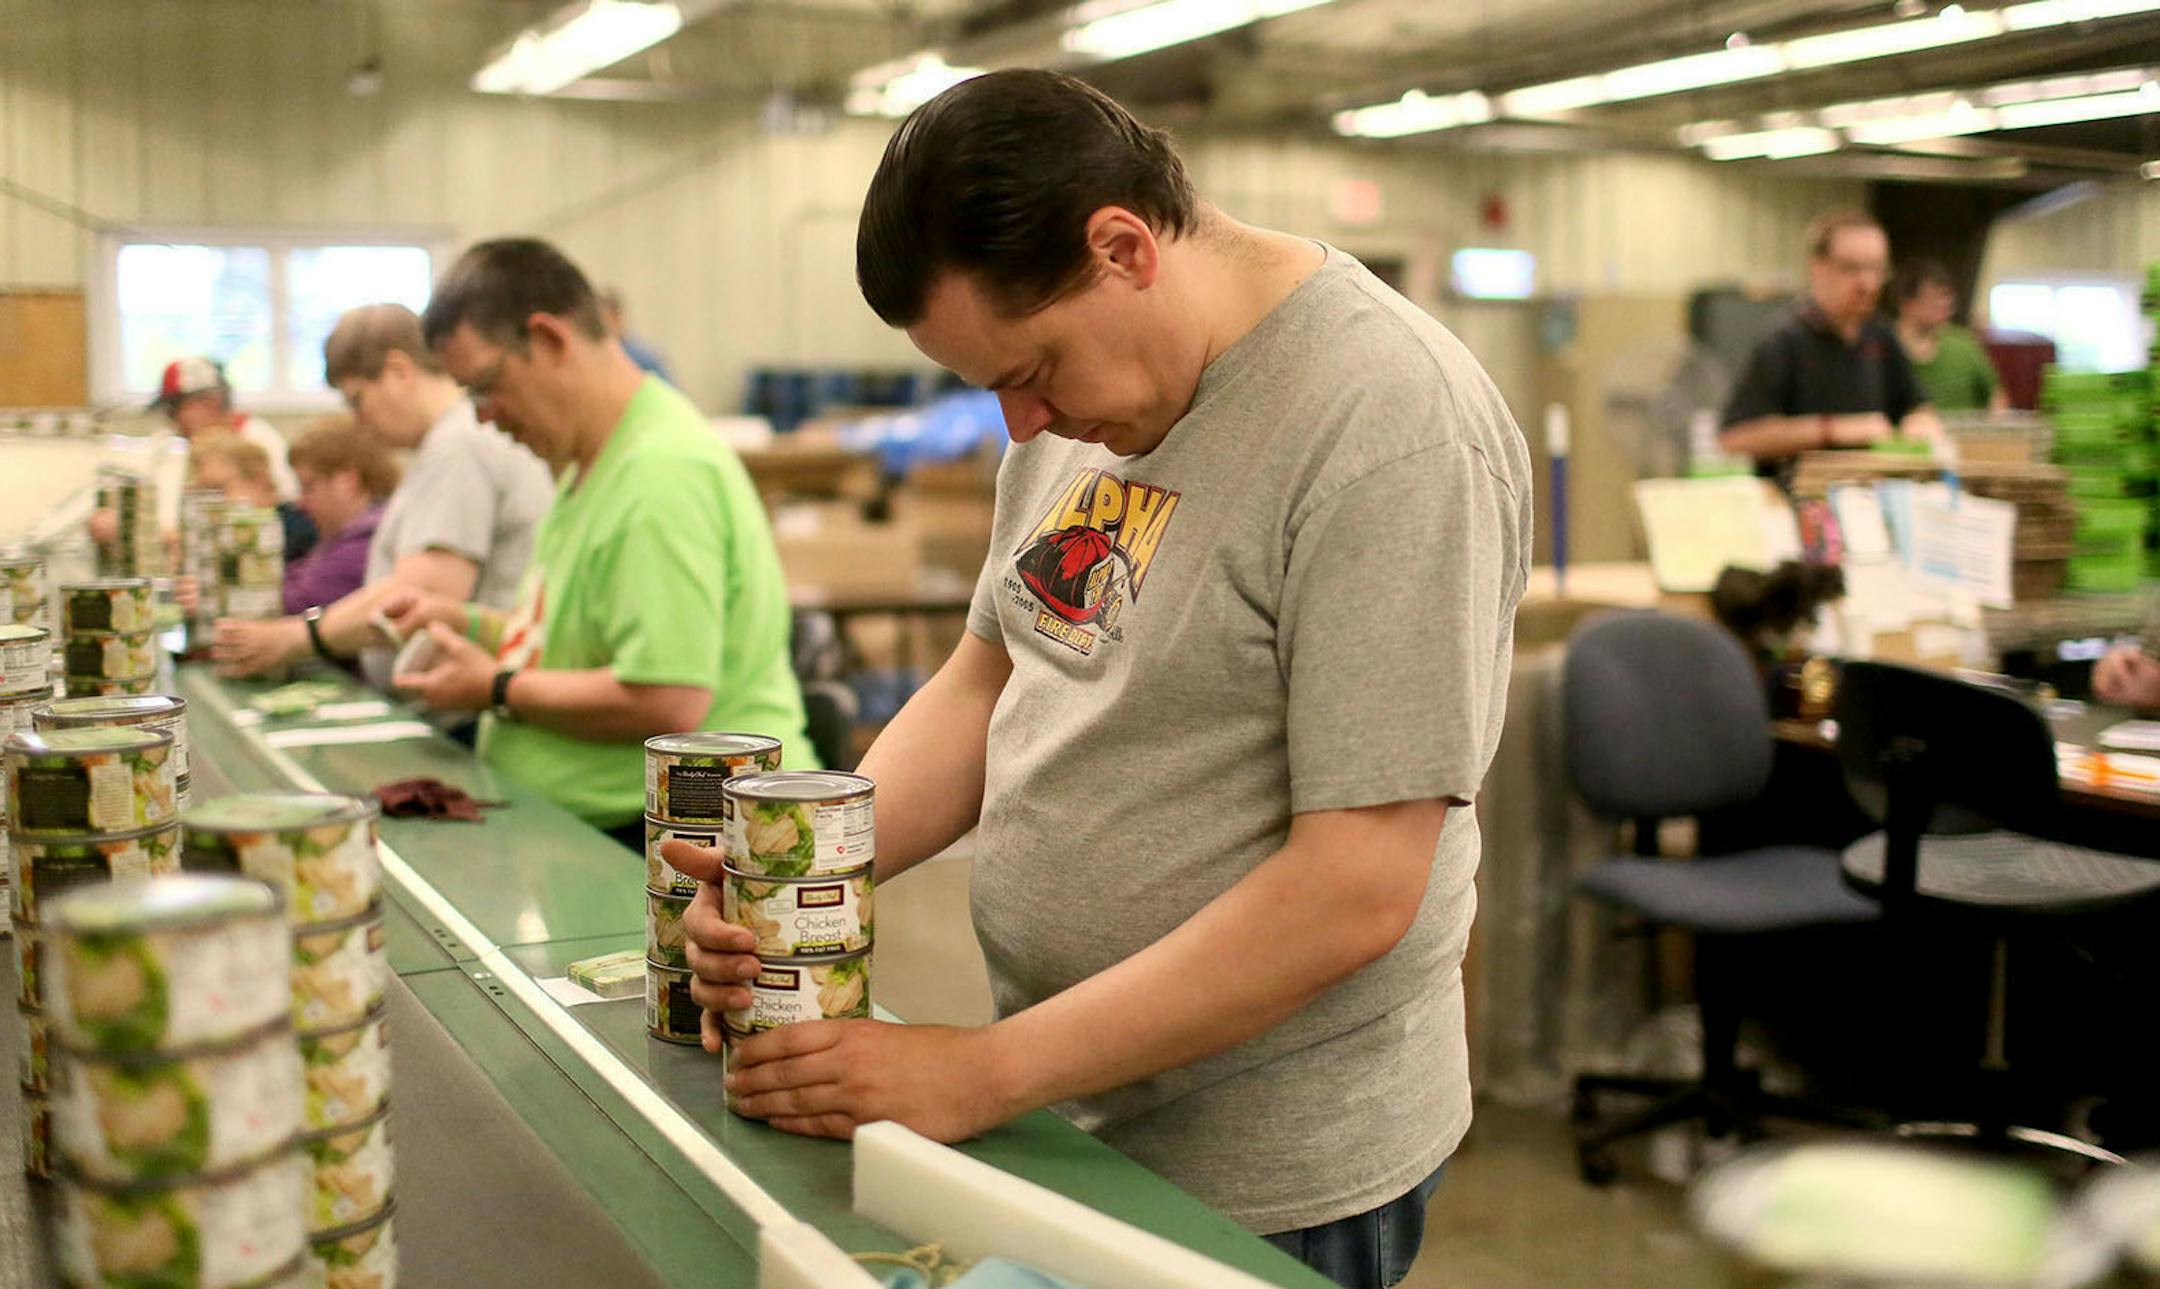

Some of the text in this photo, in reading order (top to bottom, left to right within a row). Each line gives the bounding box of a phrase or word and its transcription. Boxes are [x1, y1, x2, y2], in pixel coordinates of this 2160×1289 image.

[1013, 467, 1182, 604] ALPHA
[1038, 613, 1070, 637] FIRE
[794, 915, 846, 930] Chicken
[800, 930, 841, 943] Breast
[752, 995, 802, 1012] Chicken
[755, 1009, 796, 1025] Breast
